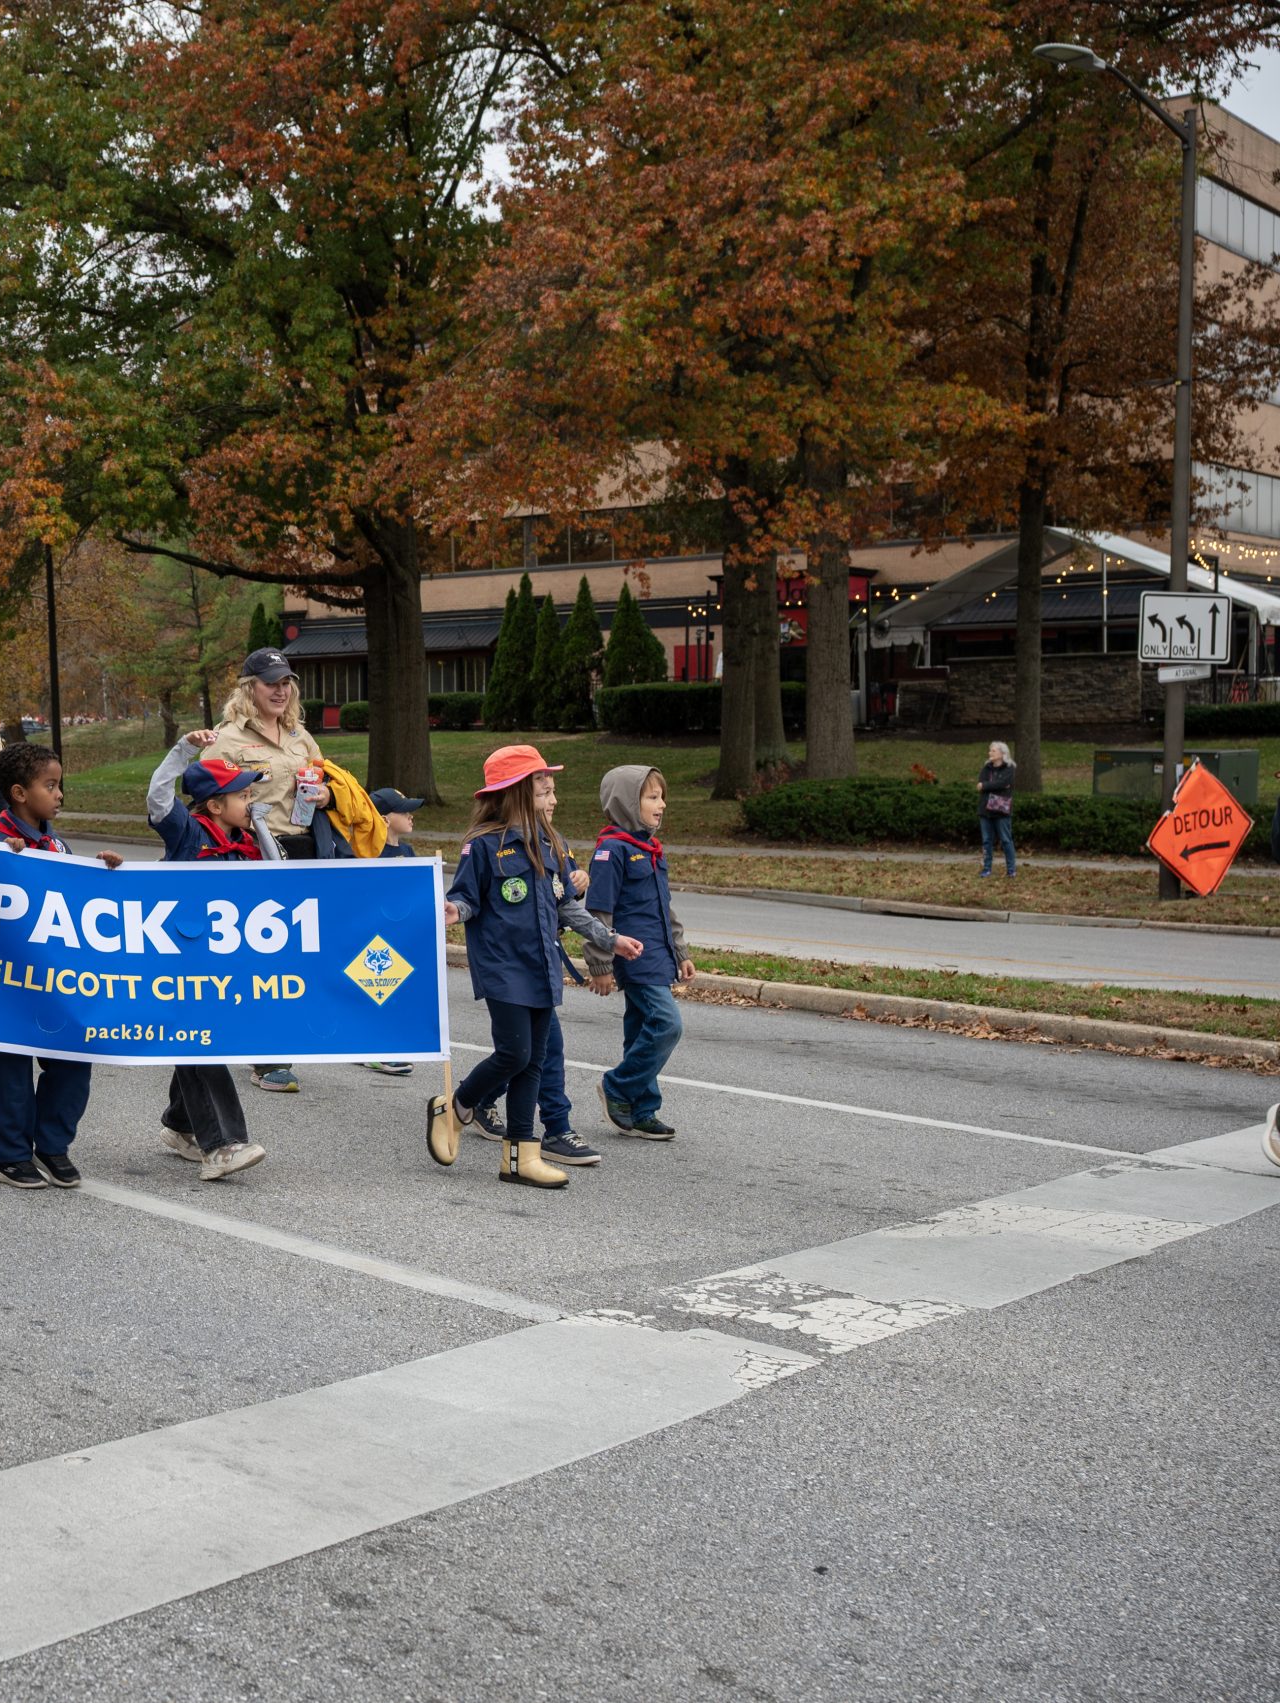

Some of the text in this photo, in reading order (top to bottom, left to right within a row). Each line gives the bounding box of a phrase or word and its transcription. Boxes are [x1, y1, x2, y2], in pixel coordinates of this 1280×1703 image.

[1144, 645, 1168, 656] ONLY
[1173, 646, 1197, 657] ONLY
[1173, 806, 1233, 835] DETOUR
[206, 898, 320, 954] 361
[151, 975, 242, 1005] CITY,
[252, 975, 306, 1000] MD
[374, 977, 401, 987] SCOUTS
[84, 1024, 212, 1045] pack361.org
